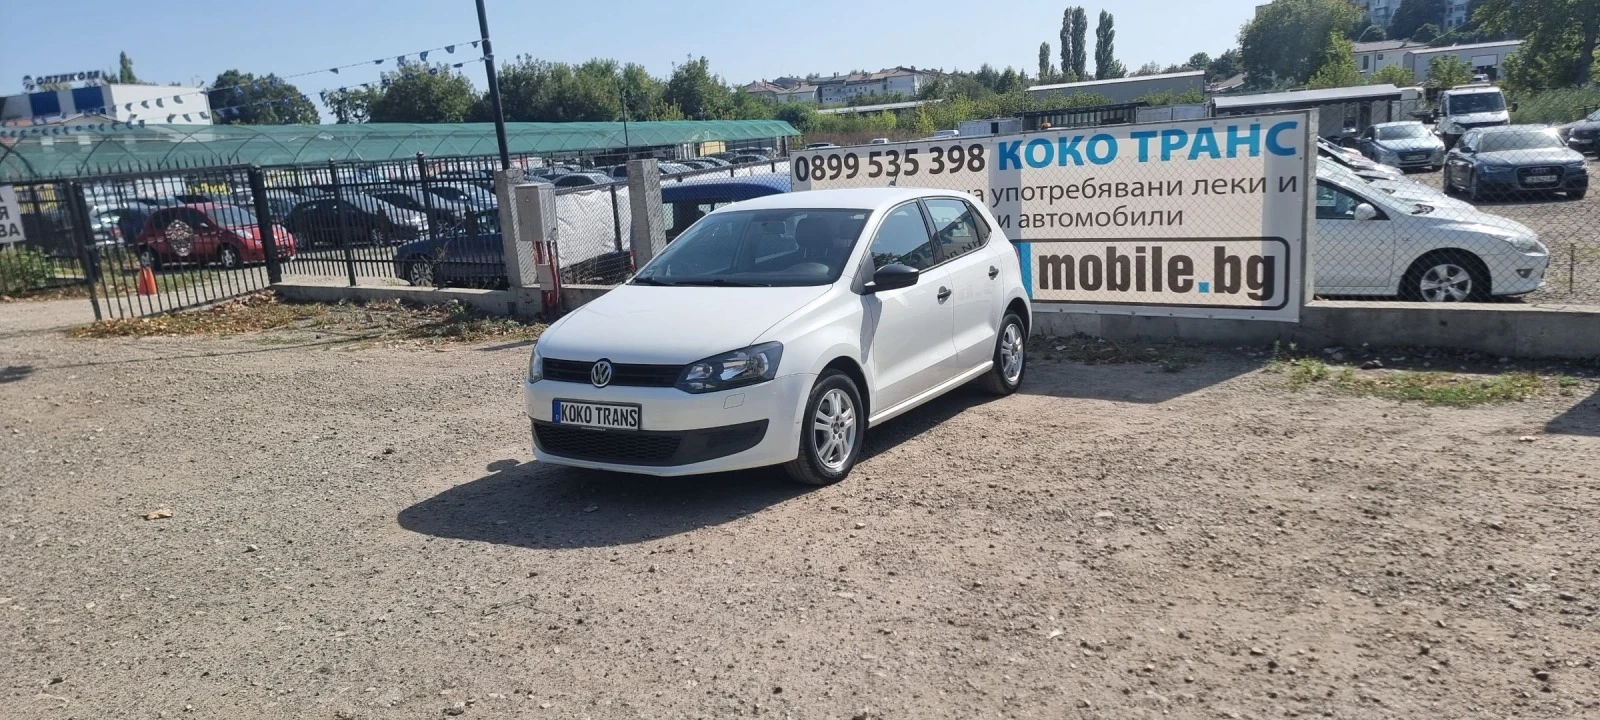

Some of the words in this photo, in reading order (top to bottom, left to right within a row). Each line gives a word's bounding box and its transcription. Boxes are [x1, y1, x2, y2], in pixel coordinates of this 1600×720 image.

[794, 153, 860, 182] 0899
[869, 148, 920, 178] 535
[930, 143, 986, 175] 398
[999, 133, 1118, 170] КОКО
[1131, 120, 1298, 162] ТРАНС
[991, 177, 1183, 207] употребявани
[1192, 176, 1267, 195] леки
[1279, 176, 1297, 193] и
[1018, 205, 1183, 228] автомобили
[1038, 245, 1275, 301] mobile.bg
[562, 404, 592, 423] KOKO
[595, 407, 638, 427] TRANS
